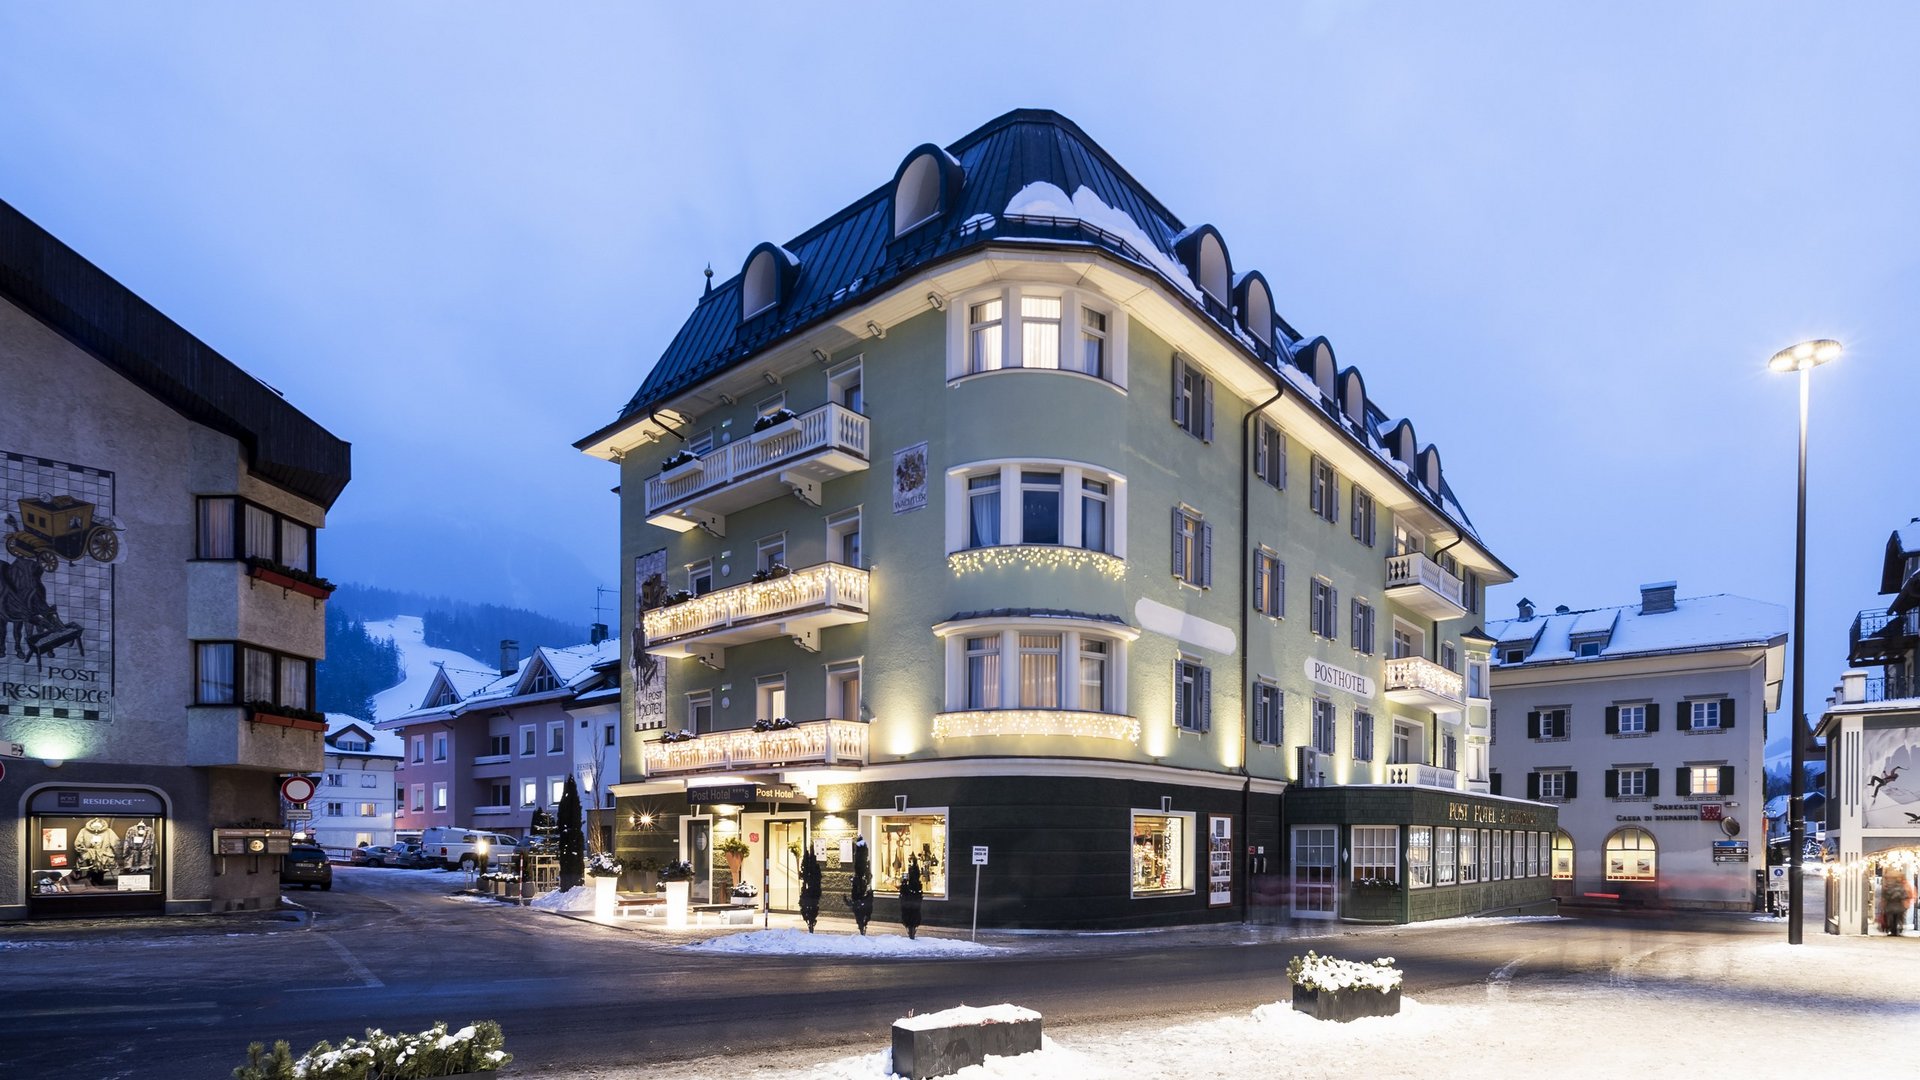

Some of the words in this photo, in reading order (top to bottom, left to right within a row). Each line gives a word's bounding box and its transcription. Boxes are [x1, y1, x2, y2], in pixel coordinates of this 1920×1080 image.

[48, 666, 100, 682] POST
[1314, 662, 1367, 695] POSTHOTEL
[2, 681, 110, 704] RESIDENCE
[648, 690, 663, 701] POST
[691, 789, 709, 801] Post
[711, 788, 731, 800] Hotel
[756, 787, 773, 798] Post
[774, 788, 794, 799] Hotel
[83, 798, 133, 806] RESIDENCE
[1449, 802, 1469, 821] POST
[1474, 804, 1497, 824] HOTEL
